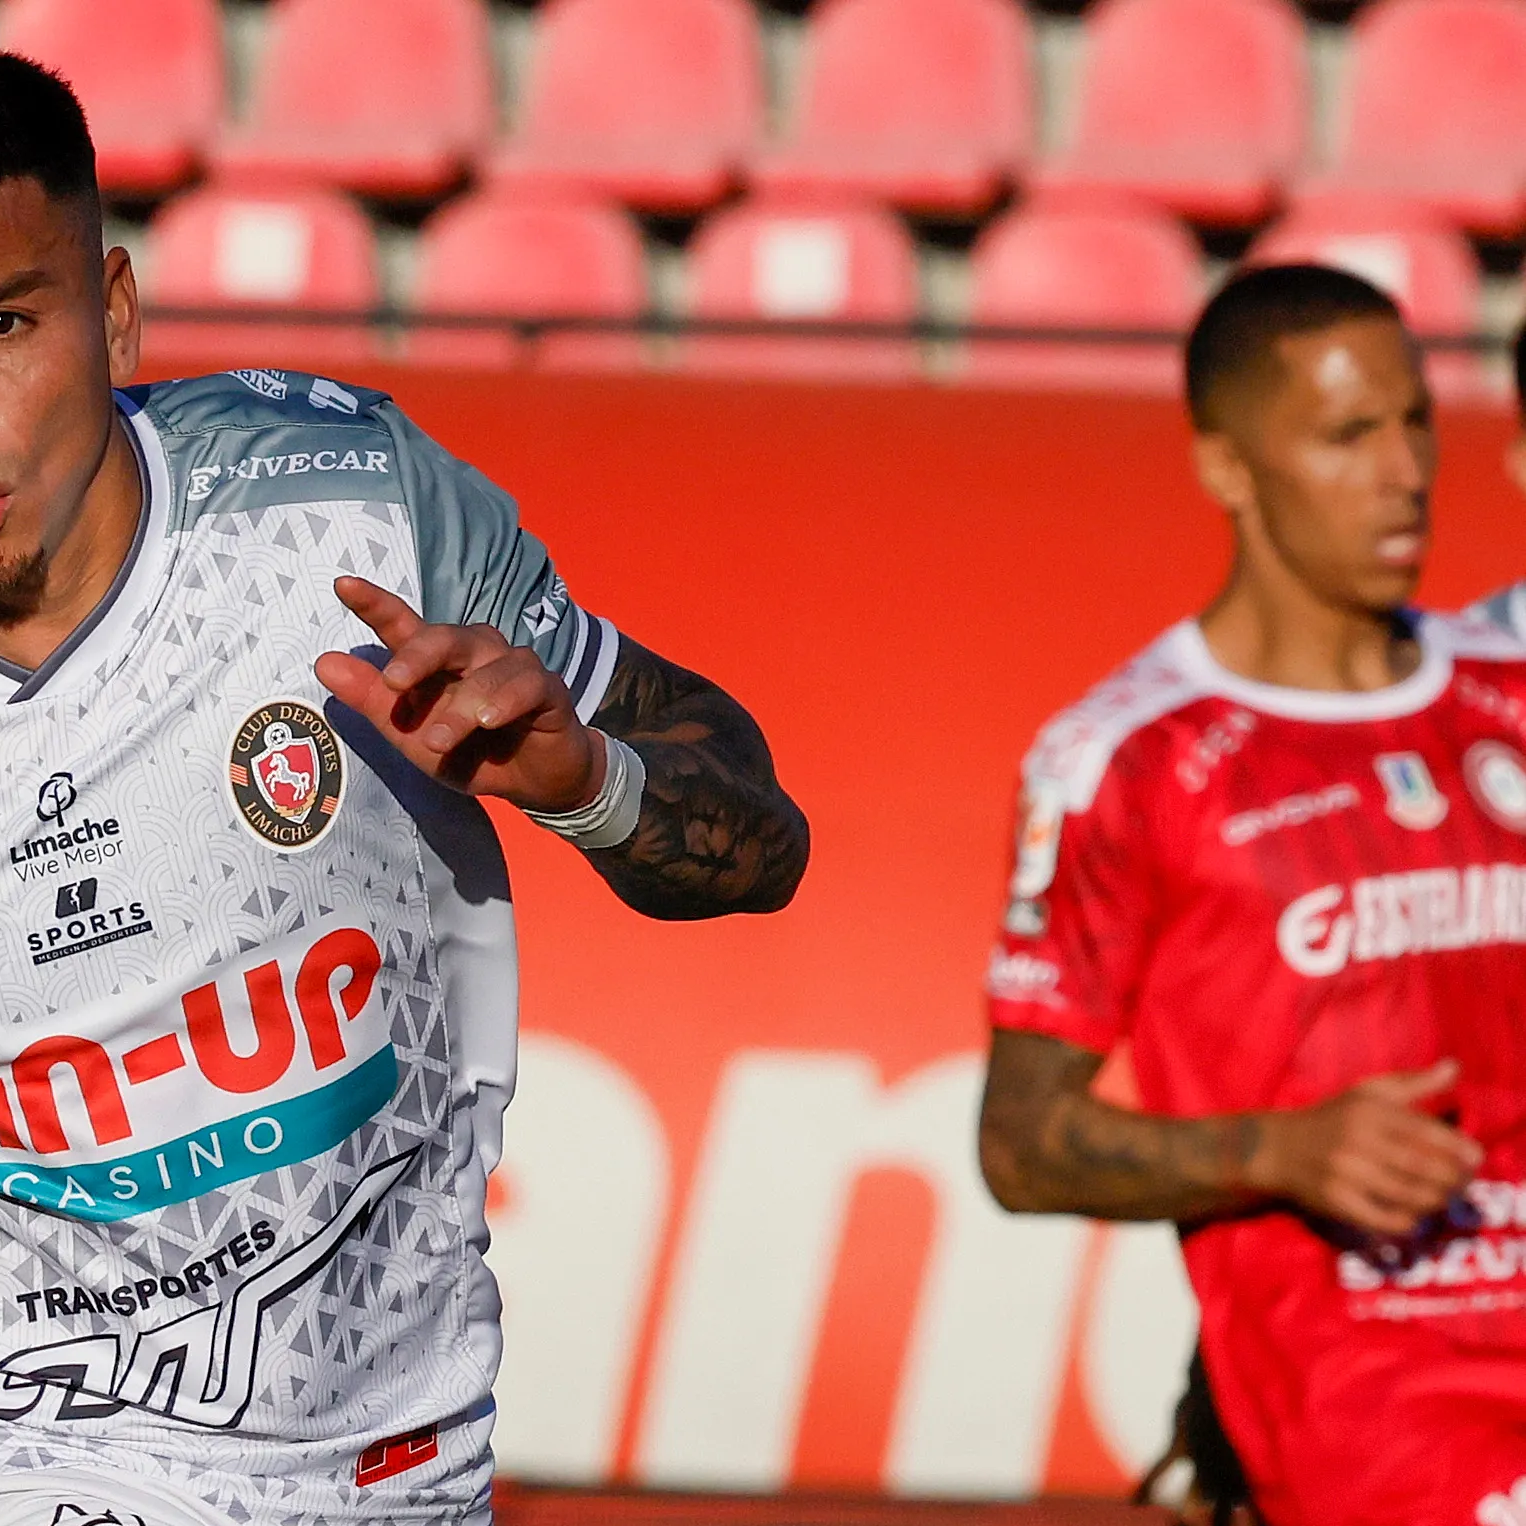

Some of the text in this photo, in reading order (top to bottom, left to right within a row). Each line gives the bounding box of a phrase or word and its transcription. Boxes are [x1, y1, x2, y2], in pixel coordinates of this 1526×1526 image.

[237, 706, 337, 773] CLUB DEPORTES
[9, 817, 120, 864] Limache
[244, 802, 313, 841] LIMACHE
[14, 838, 125, 882] Vive Mejor
[27, 902, 146, 951] SPORTS
[37, 924, 148, 963] MEDICINA DEPORTIVA
[2, 1116, 284, 1208] CASINO
[17, 1221, 276, 1323] TRANSPORTES
